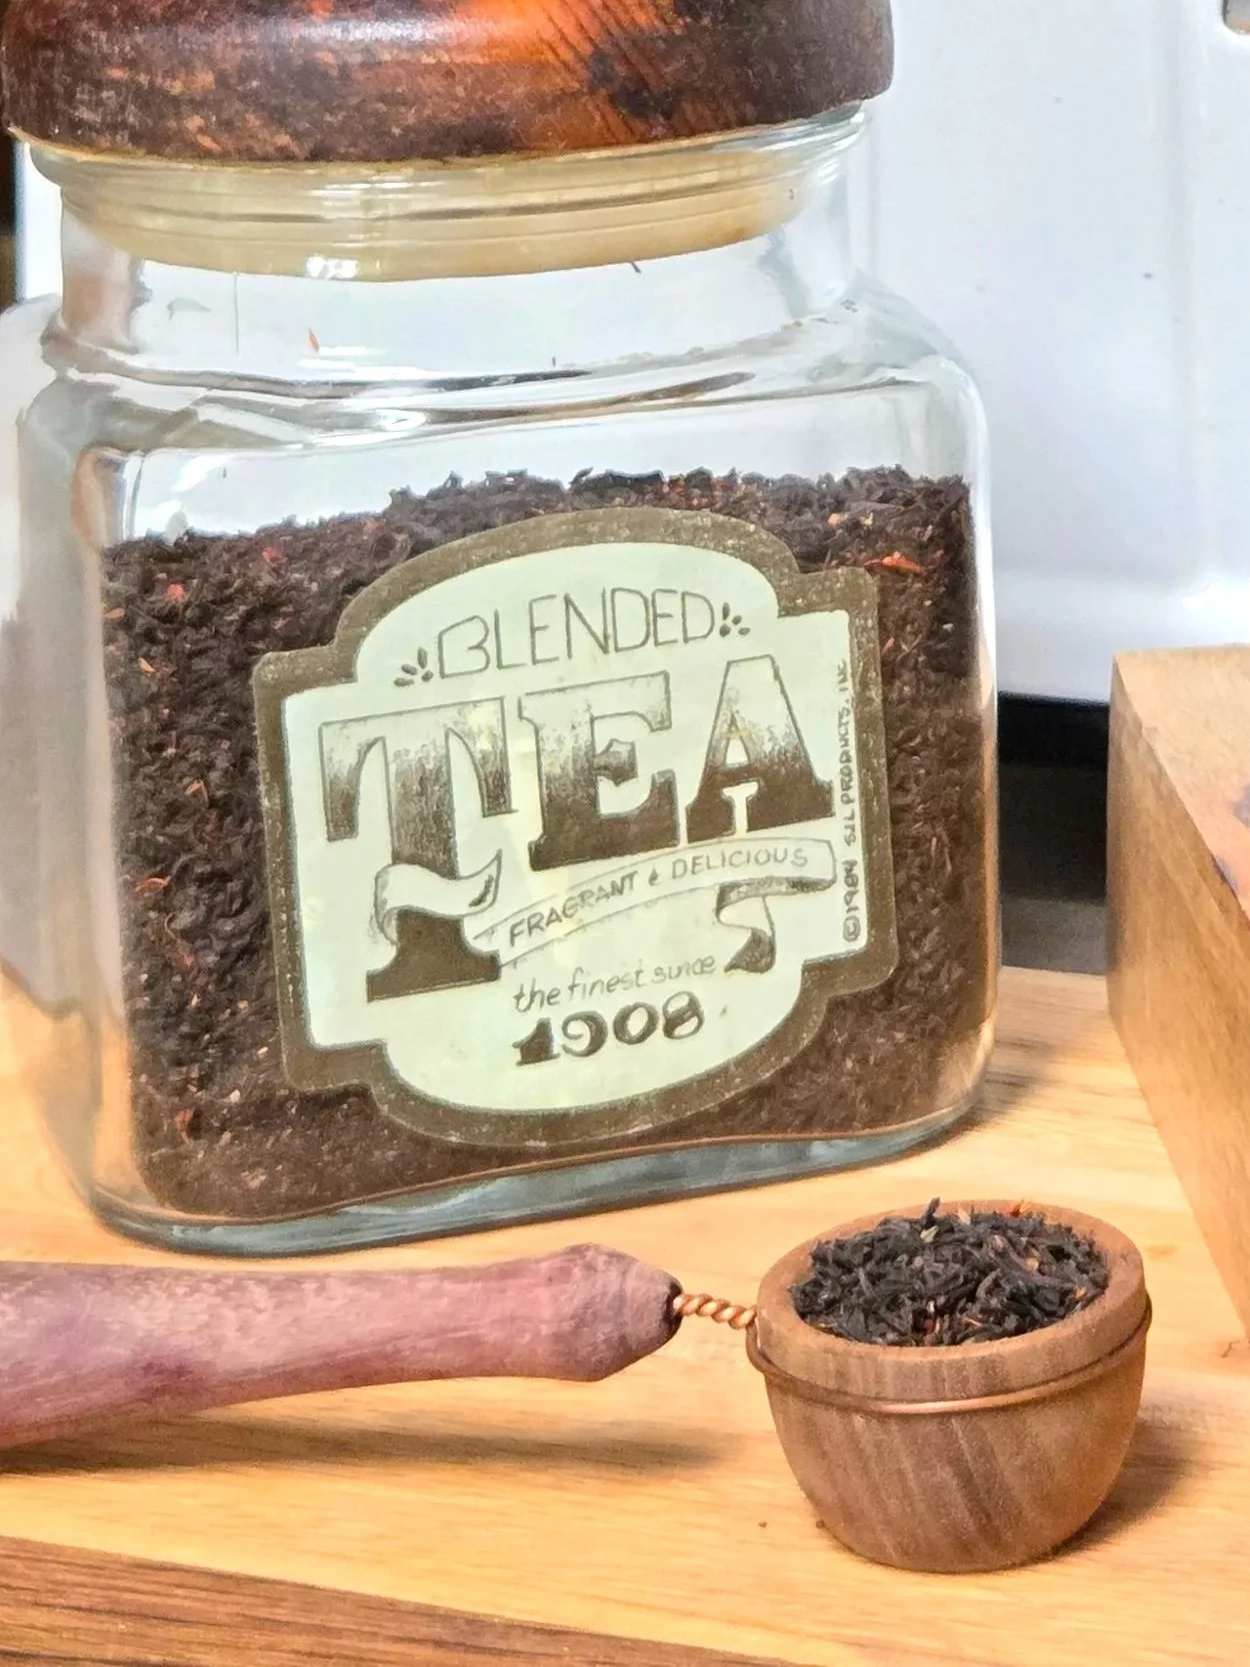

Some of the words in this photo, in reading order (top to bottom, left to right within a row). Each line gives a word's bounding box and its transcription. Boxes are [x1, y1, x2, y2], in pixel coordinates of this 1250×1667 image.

[438, 587, 717, 679] BLENDED
[319, 654, 835, 1002] TEA
[509, 870, 640, 948] FRAGRANT
[671, 846, 809, 880] DELICIOUS
[511, 990, 706, 1067] 1908
[513, 978, 561, 1014] the
[568, 966, 647, 1001] finest
